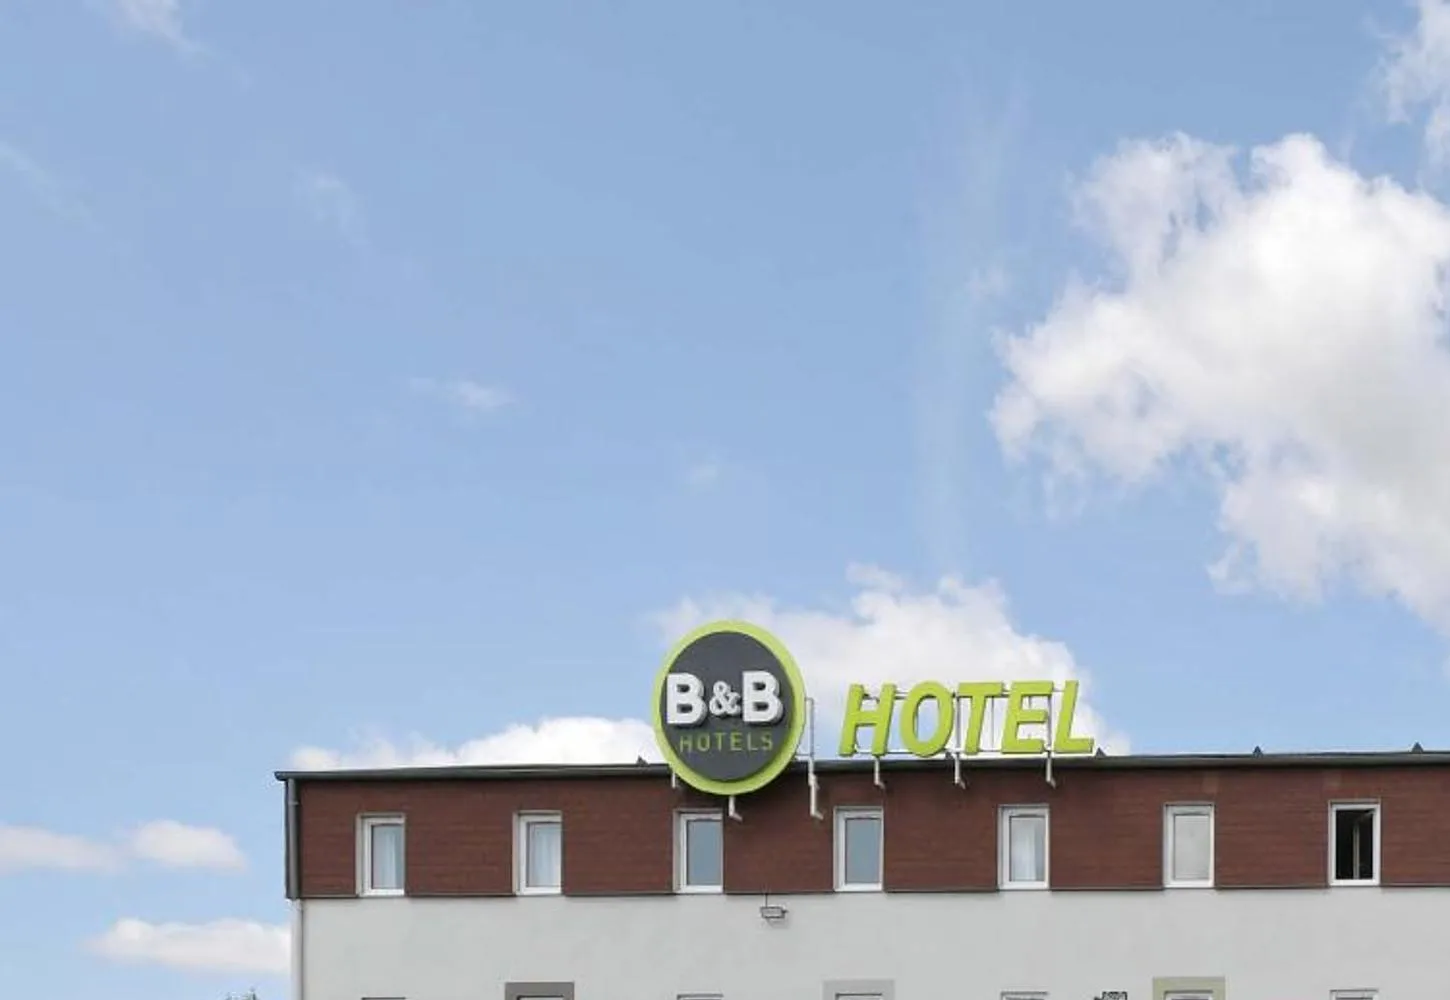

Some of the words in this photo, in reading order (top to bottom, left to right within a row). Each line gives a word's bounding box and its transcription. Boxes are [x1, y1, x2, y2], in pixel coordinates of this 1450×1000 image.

[666, 671, 784, 726] B&B
[838, 680, 1096, 757] HOTEL
[680, 732, 774, 752] HOTELS
